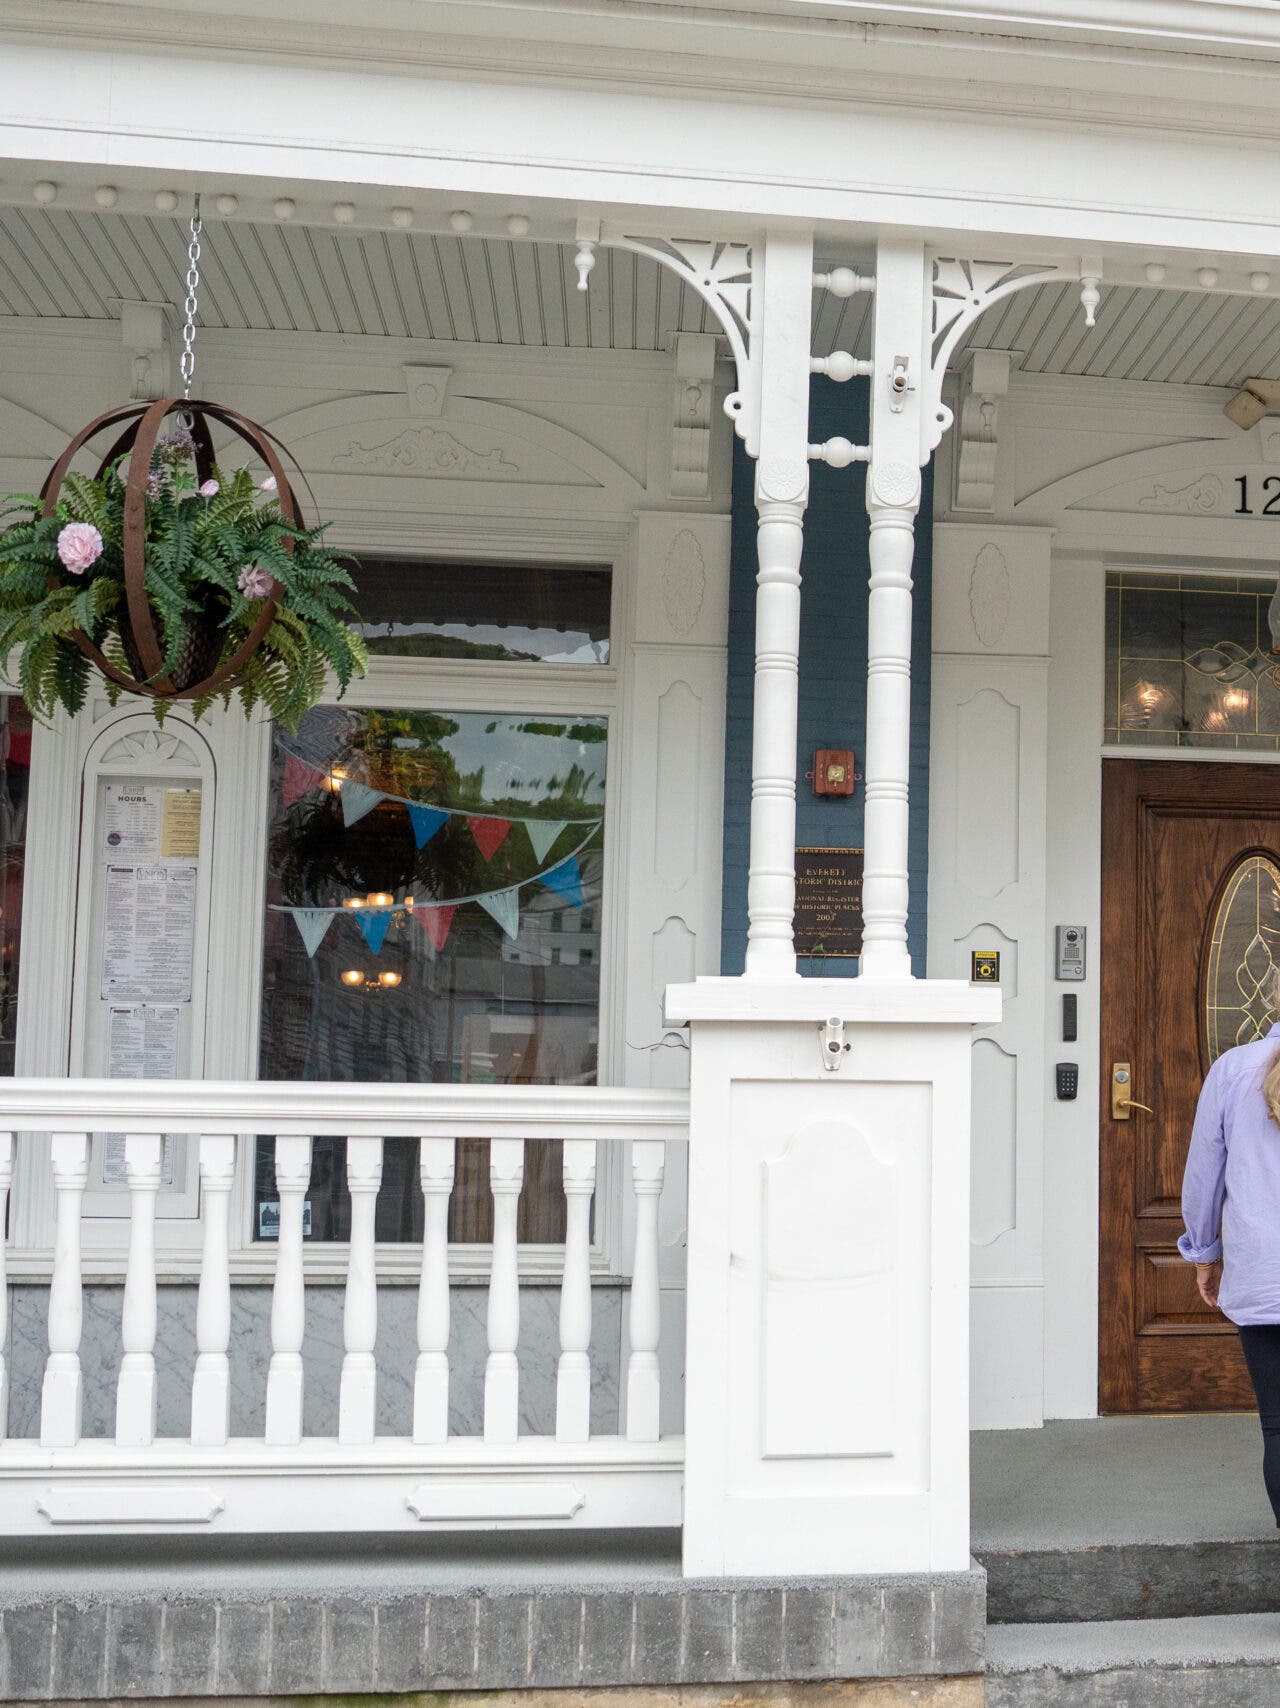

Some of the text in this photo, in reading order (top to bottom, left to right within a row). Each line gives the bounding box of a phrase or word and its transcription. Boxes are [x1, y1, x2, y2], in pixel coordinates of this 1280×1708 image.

[806, 868, 845, 876] EVERETT
[795, 877, 863, 886] TORIC DISTRIC
